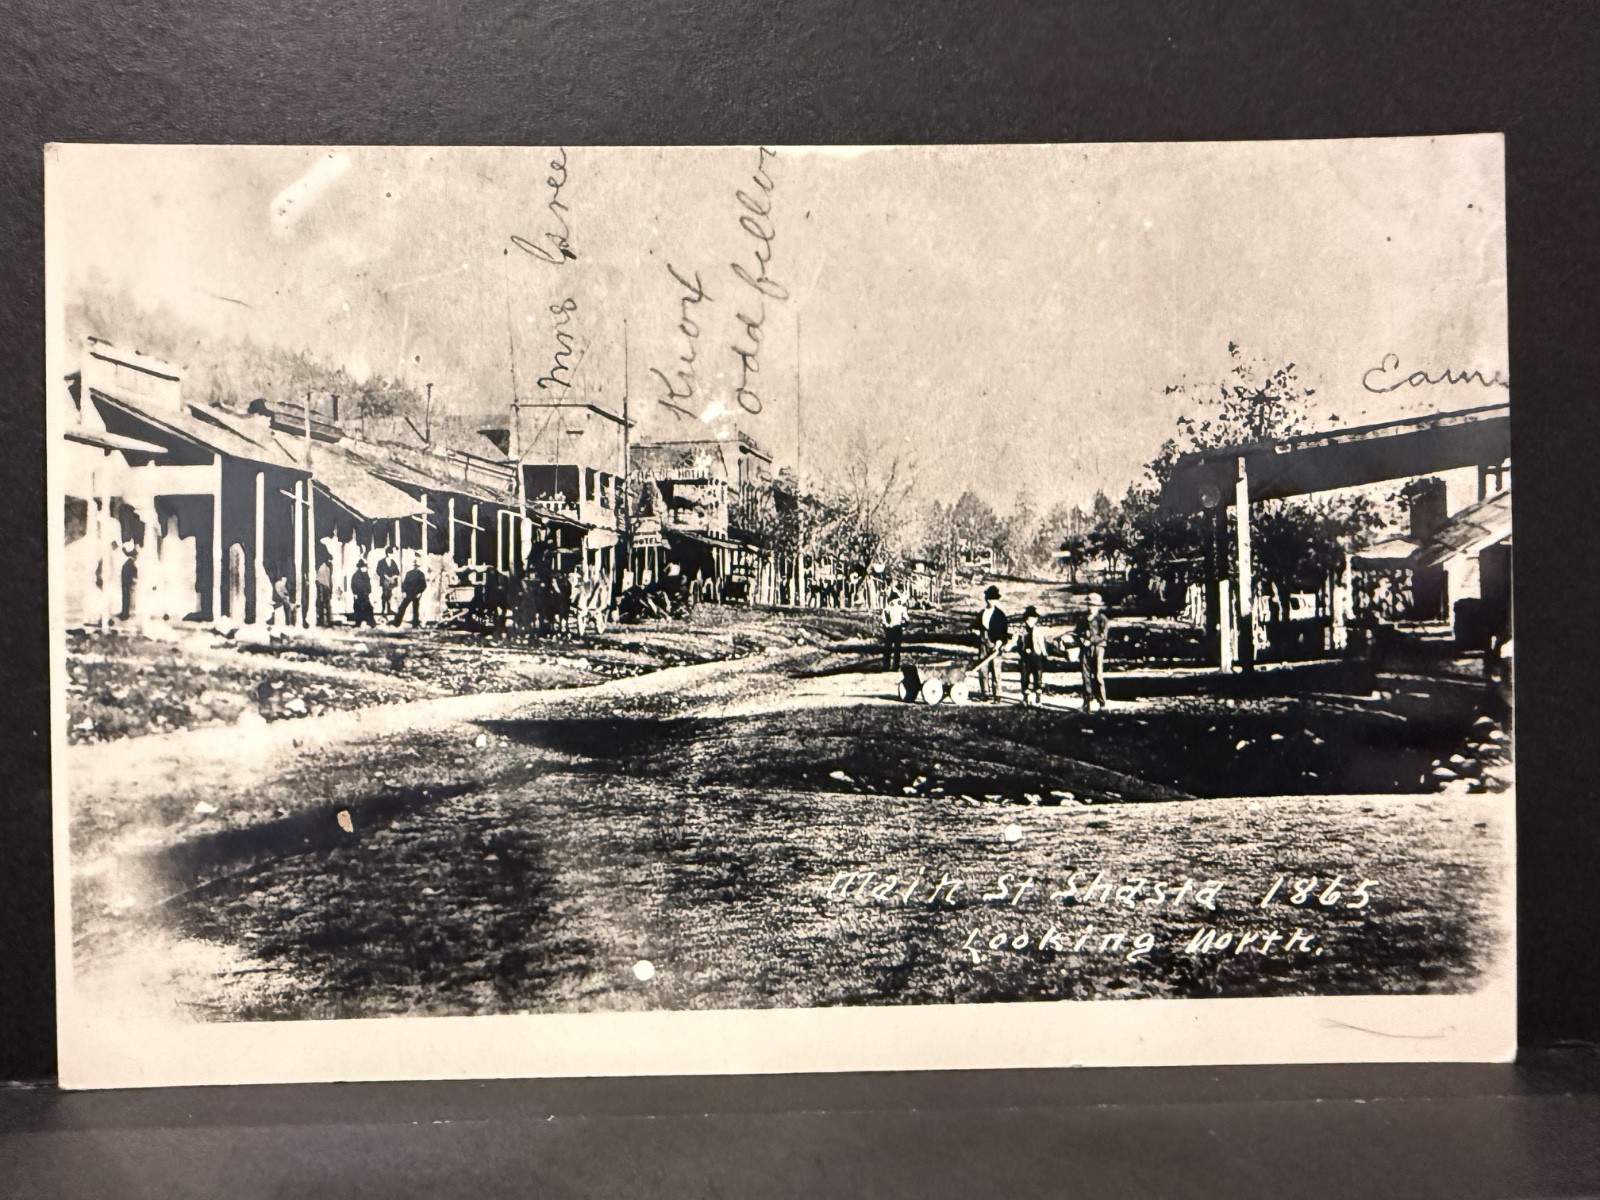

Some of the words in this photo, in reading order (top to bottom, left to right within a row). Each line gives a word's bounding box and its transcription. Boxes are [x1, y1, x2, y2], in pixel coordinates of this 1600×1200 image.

[826, 866, 963, 905] Main
[983, 873, 1035, 906] St
[1050, 870, 1224, 910] Shasta
[1260, 876, 1380, 909] 1865
[962, 924, 1156, 964] Looking
